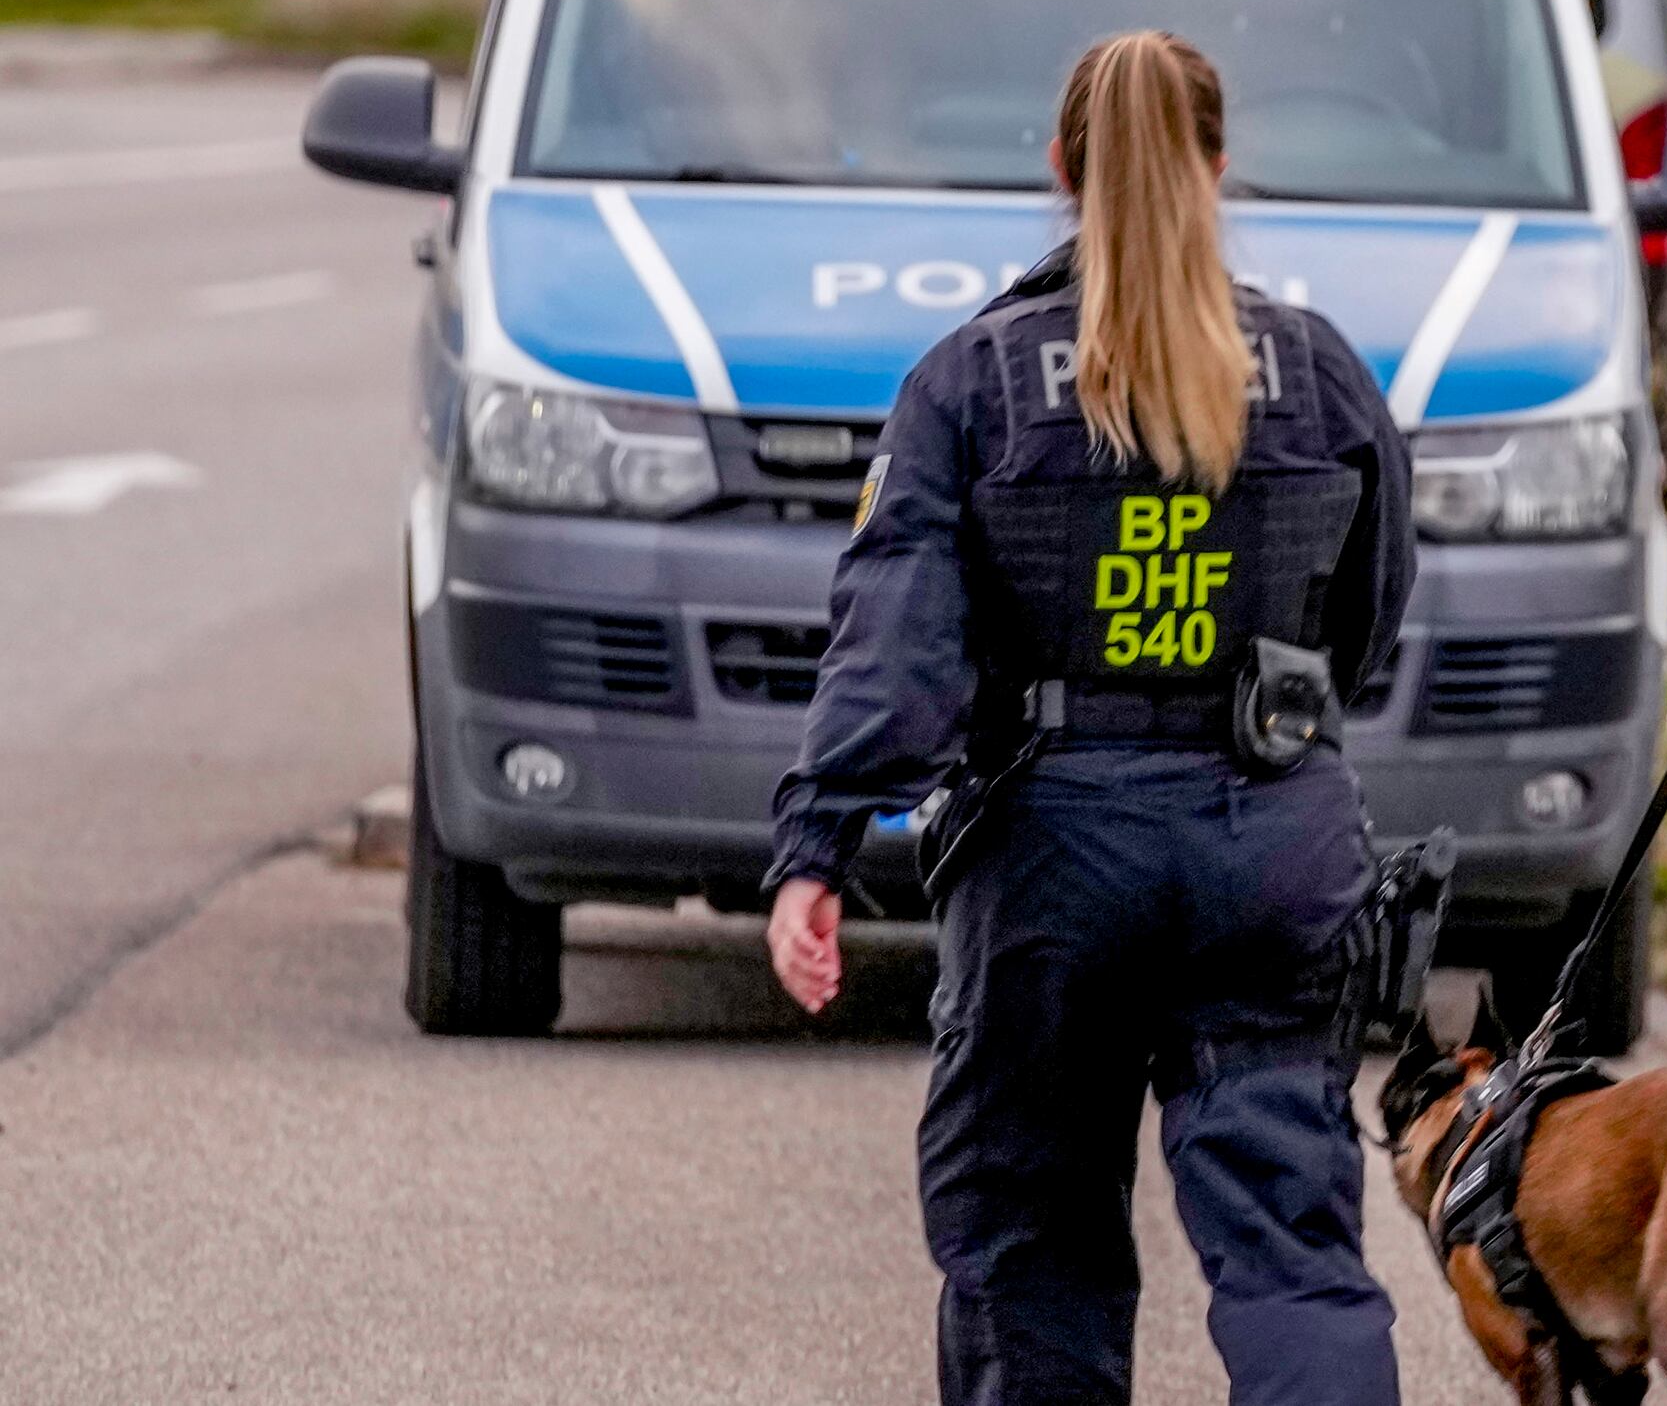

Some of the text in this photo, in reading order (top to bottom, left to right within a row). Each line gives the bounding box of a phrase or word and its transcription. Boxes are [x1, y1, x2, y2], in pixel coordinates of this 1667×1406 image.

[1119, 494, 1211, 551] BP
[1095, 551, 1233, 609] DHF
[1103, 609, 1217, 667] 540
